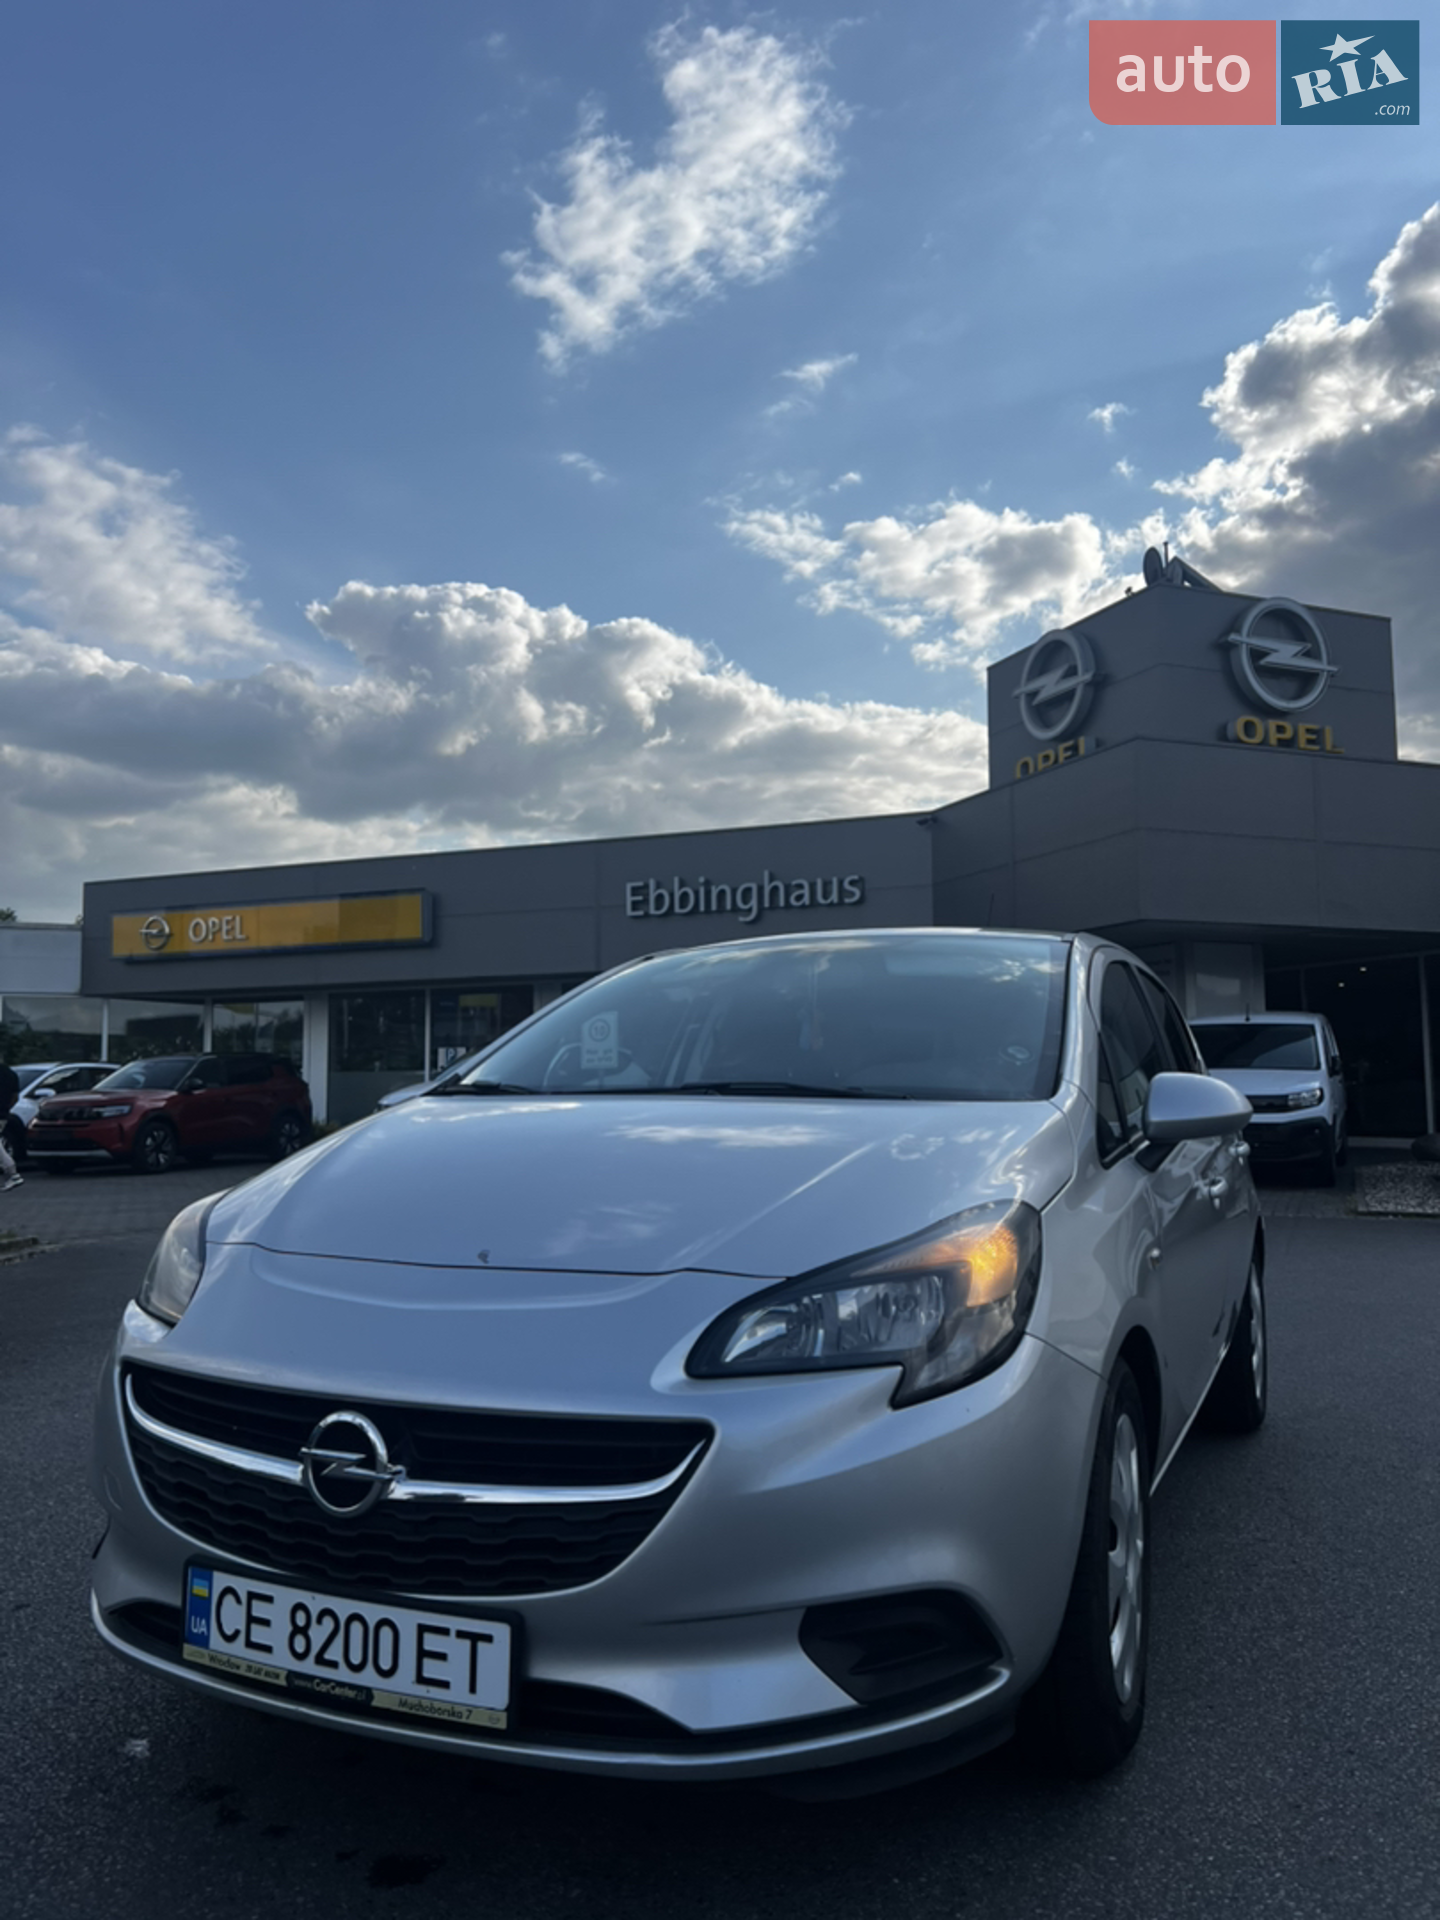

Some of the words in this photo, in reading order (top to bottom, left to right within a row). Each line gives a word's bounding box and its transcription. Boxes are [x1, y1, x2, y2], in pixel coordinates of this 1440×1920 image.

[1236, 716, 1344, 754] OPEL
[625, 870, 862, 922] Ebbinghaus
[188, 915, 247, 943] OPEL
[191, 1615, 208, 1636] UA
[215, 1585, 274, 1654] CE
[288, 1602, 399, 1679] 8200
[416, 1623, 494, 1695] ET
